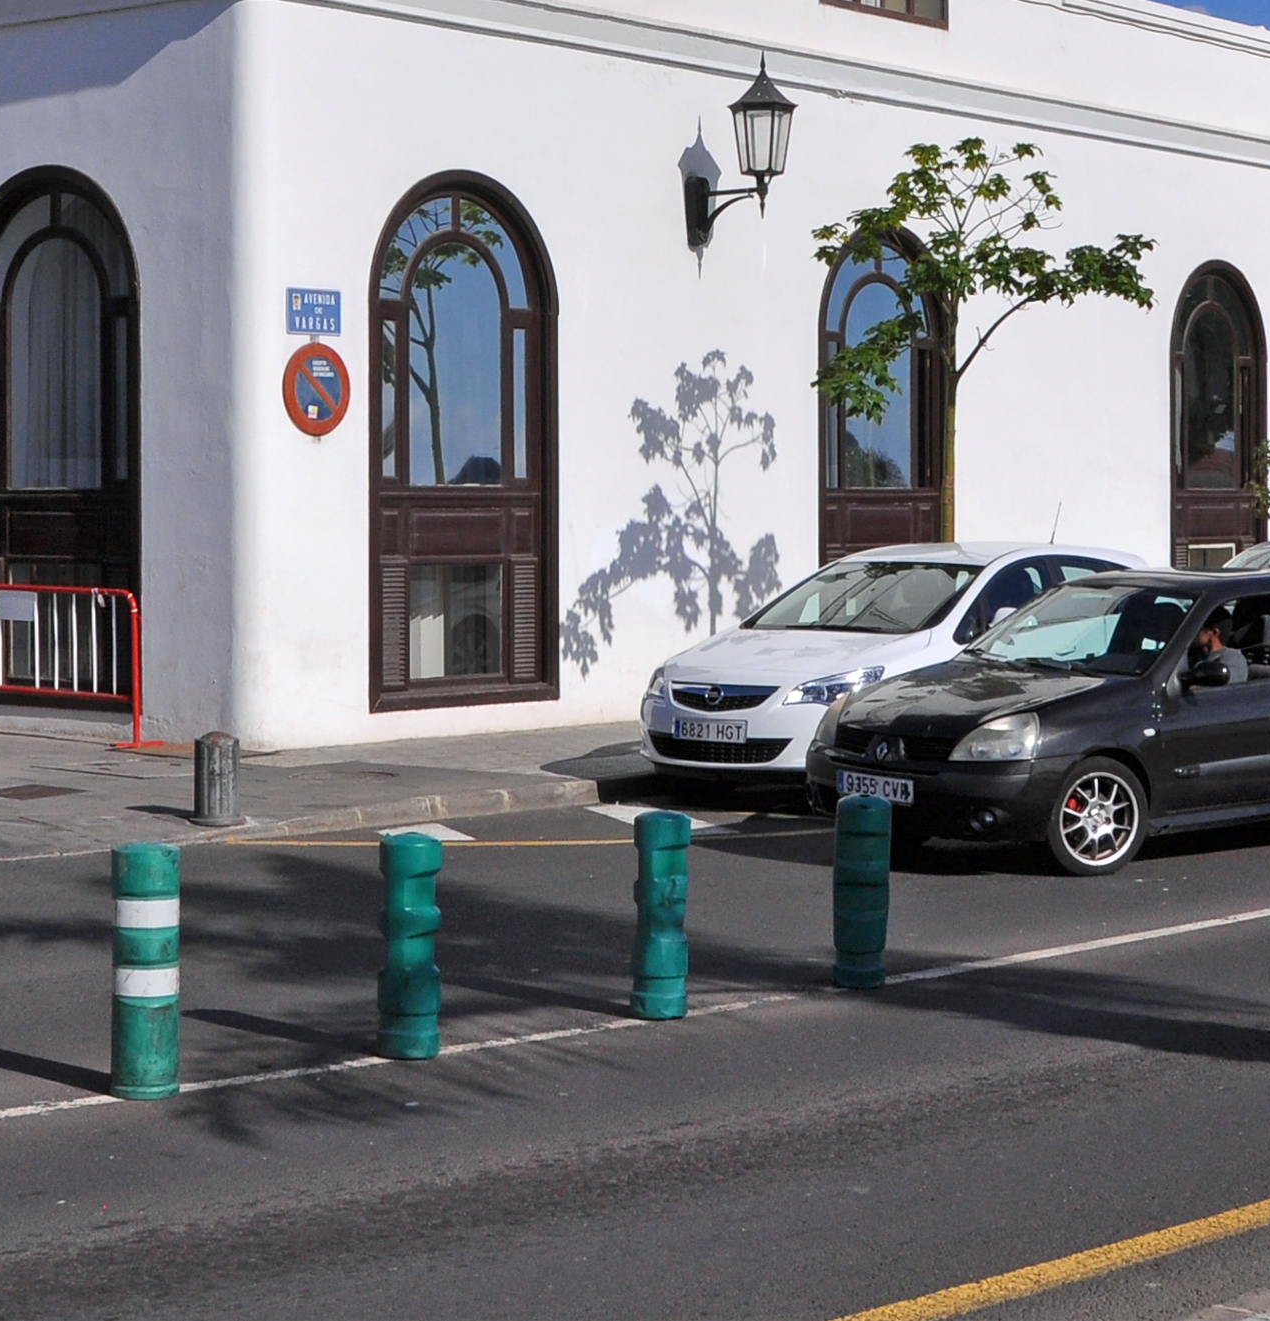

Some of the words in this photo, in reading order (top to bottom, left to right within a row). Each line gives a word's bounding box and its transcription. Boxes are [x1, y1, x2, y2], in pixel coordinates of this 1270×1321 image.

[304, 293, 335, 305] AVENIDA
[295, 316, 335, 331] VARGAS
[681, 721, 711, 740] 6821
[716, 723, 743, 741] HGT
[846, 773, 878, 795] 9355
